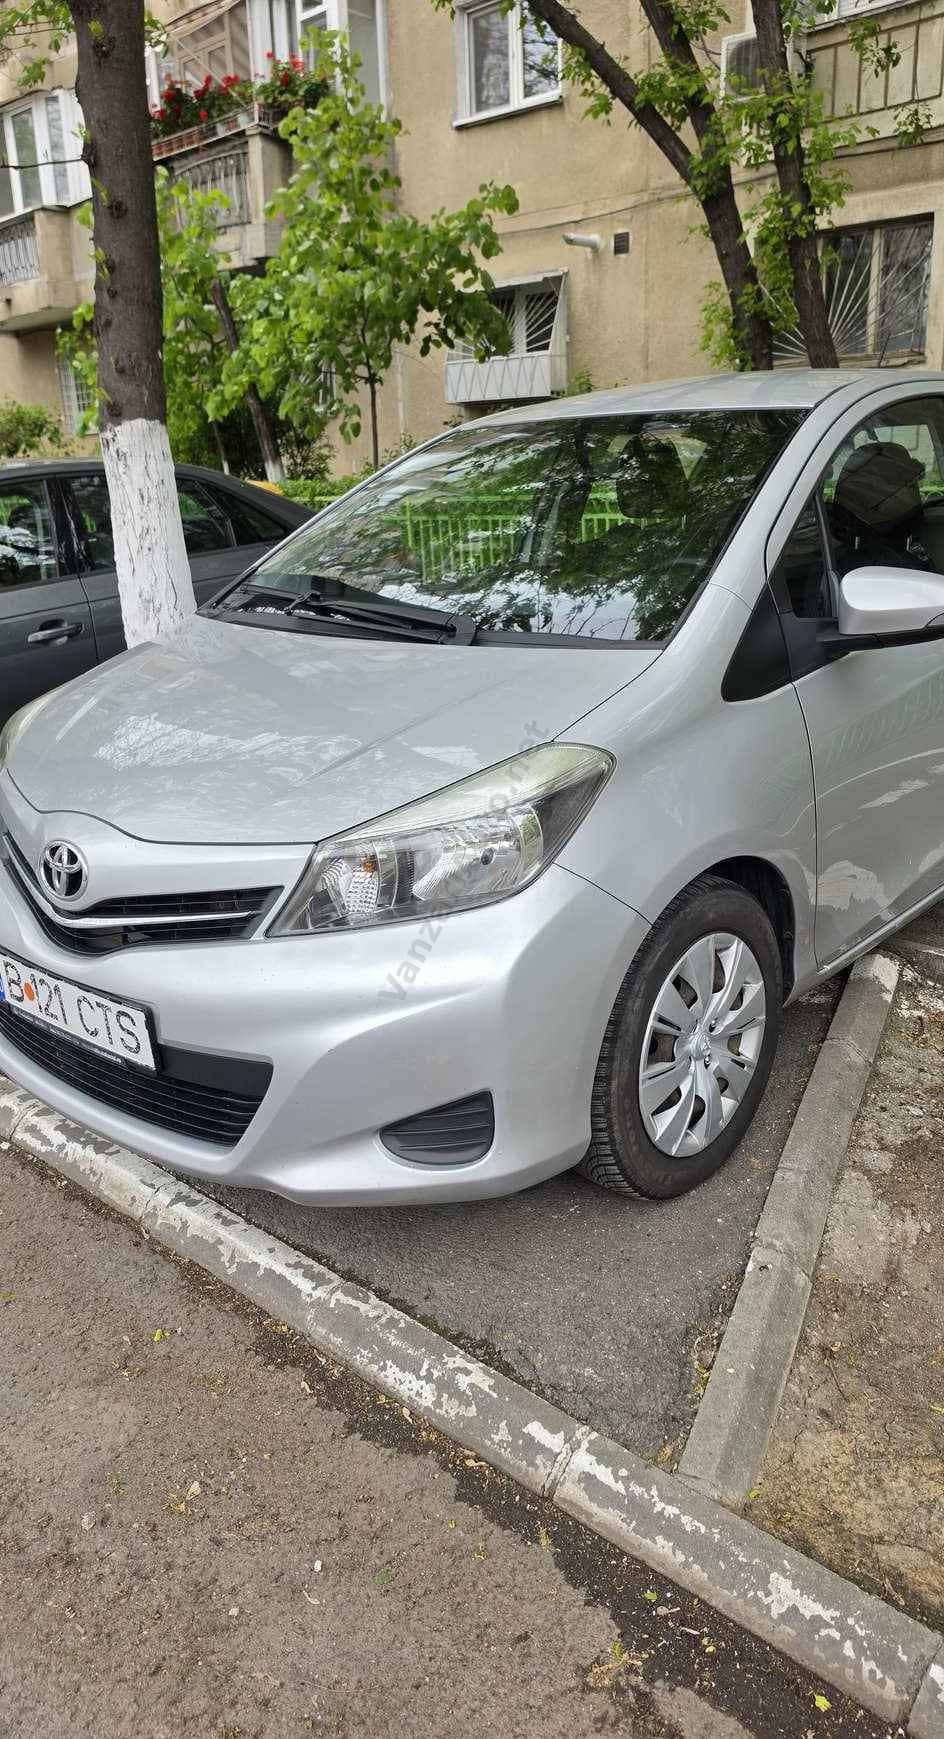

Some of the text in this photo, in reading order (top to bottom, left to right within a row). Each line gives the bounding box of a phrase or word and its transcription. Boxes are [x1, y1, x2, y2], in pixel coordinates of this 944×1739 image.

[3, 959, 25, 1002] B
[30, 973, 68, 1025] 121
[77, 995, 141, 1054] CTS
